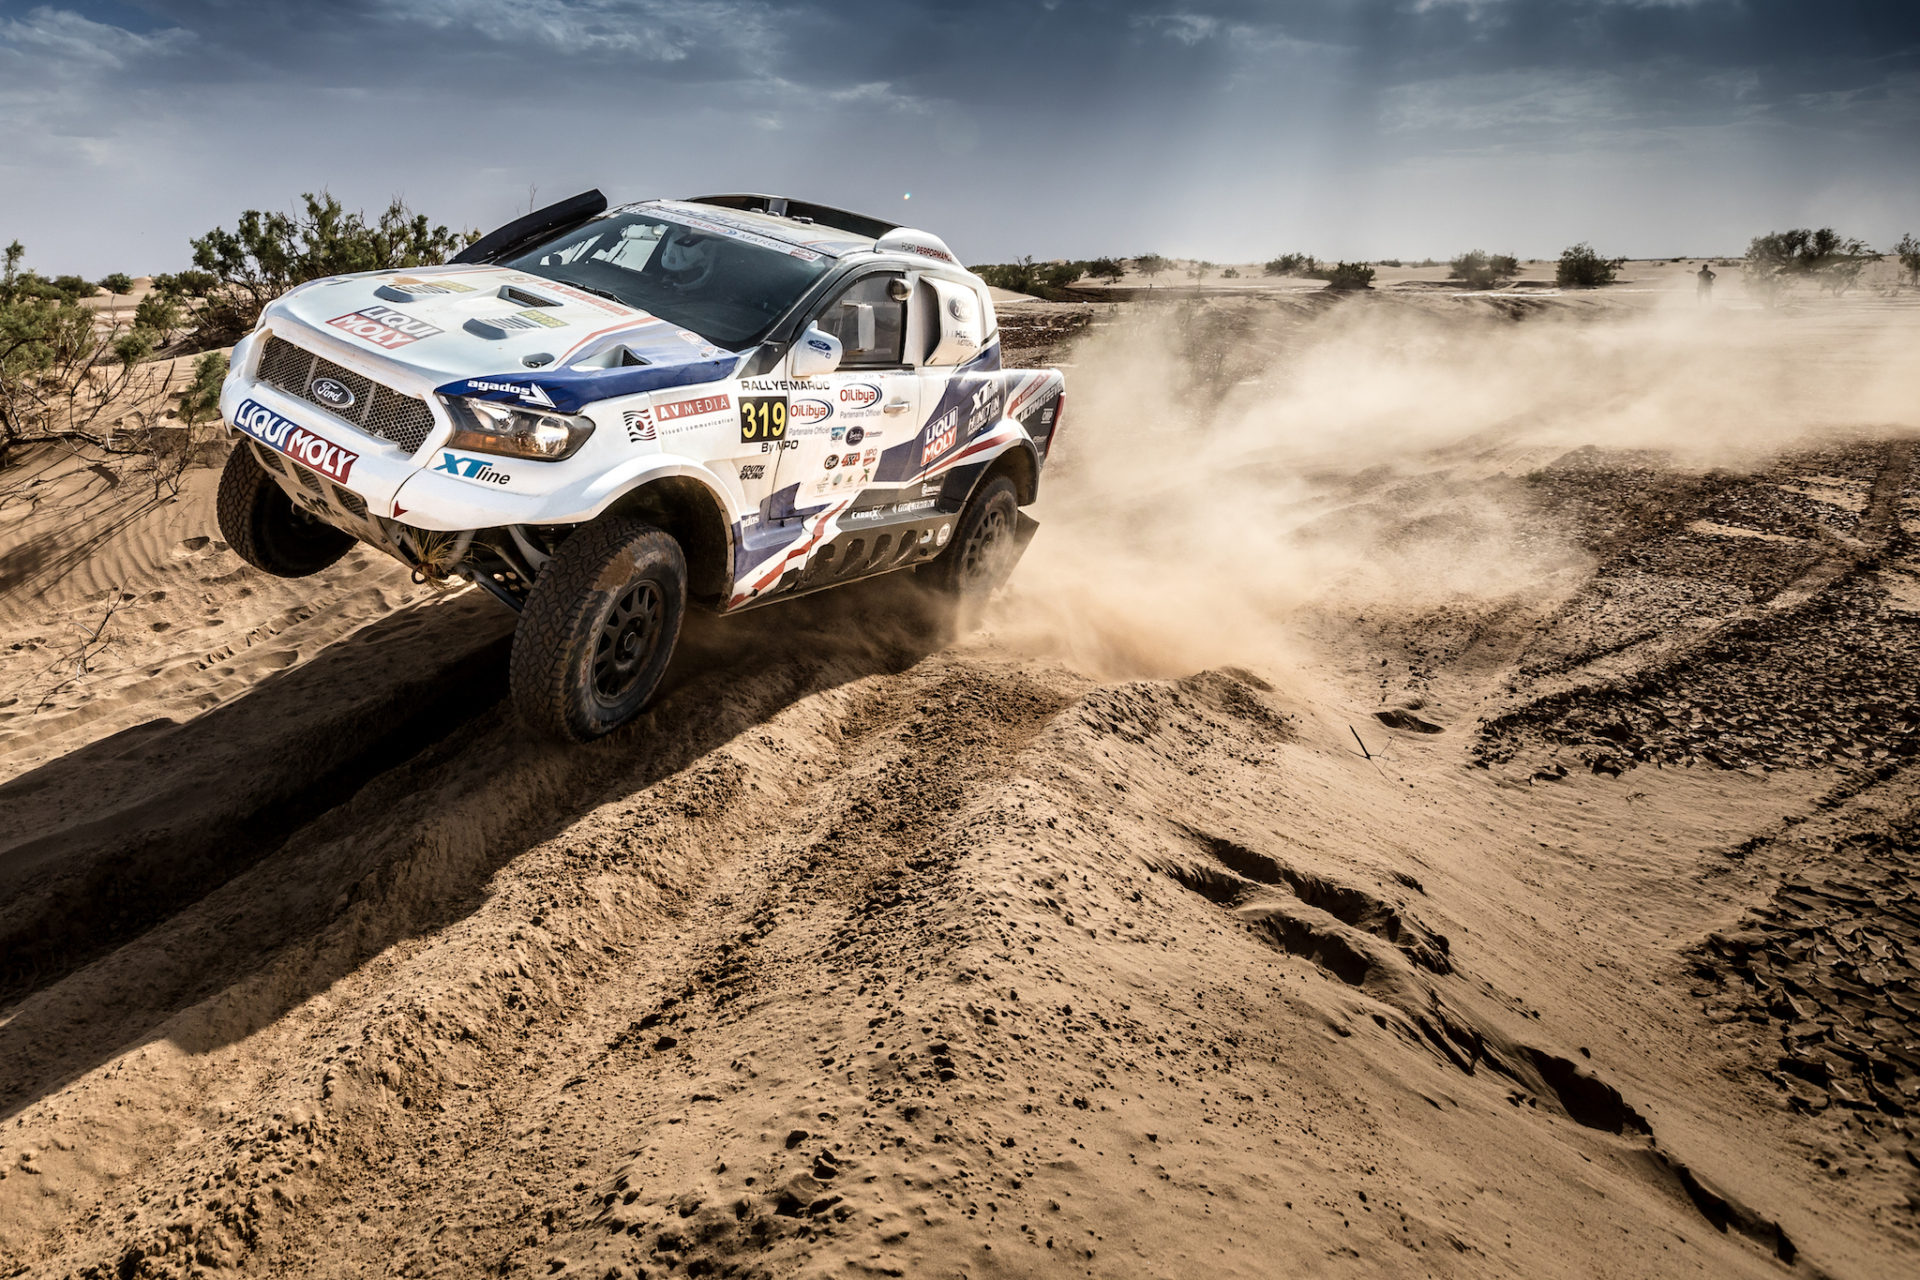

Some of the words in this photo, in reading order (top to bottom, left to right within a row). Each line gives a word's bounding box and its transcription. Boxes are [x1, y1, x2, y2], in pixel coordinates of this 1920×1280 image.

[330, 313, 414, 346] MOLY
[359, 306, 441, 338] LIQUI
[317, 381, 343, 402] Ford
[468, 380, 531, 396] agados
[741, 380, 788, 391] RALLYE
[790, 380, 831, 391] MAROC
[840, 388, 876, 404] OiLibya
[790, 404, 827, 419] OiLibya
[840, 411, 864, 419] Partenaire
[741, 401, 787, 440] 319
[925, 410, 956, 446] LIQUI
[236, 400, 294, 448] LIQUI
[287, 428, 357, 478] MOLY
[788, 427, 814, 437] Partenaire
[761, 442, 775, 454] By
[775, 439, 799, 452] NPO
[864, 448, 878, 457] NPO
[923, 430, 955, 463] MOLY
[433, 452, 511, 485] XTline
[739, 471, 765, 481] RACING
[740, 464, 766, 474] SOUTH
